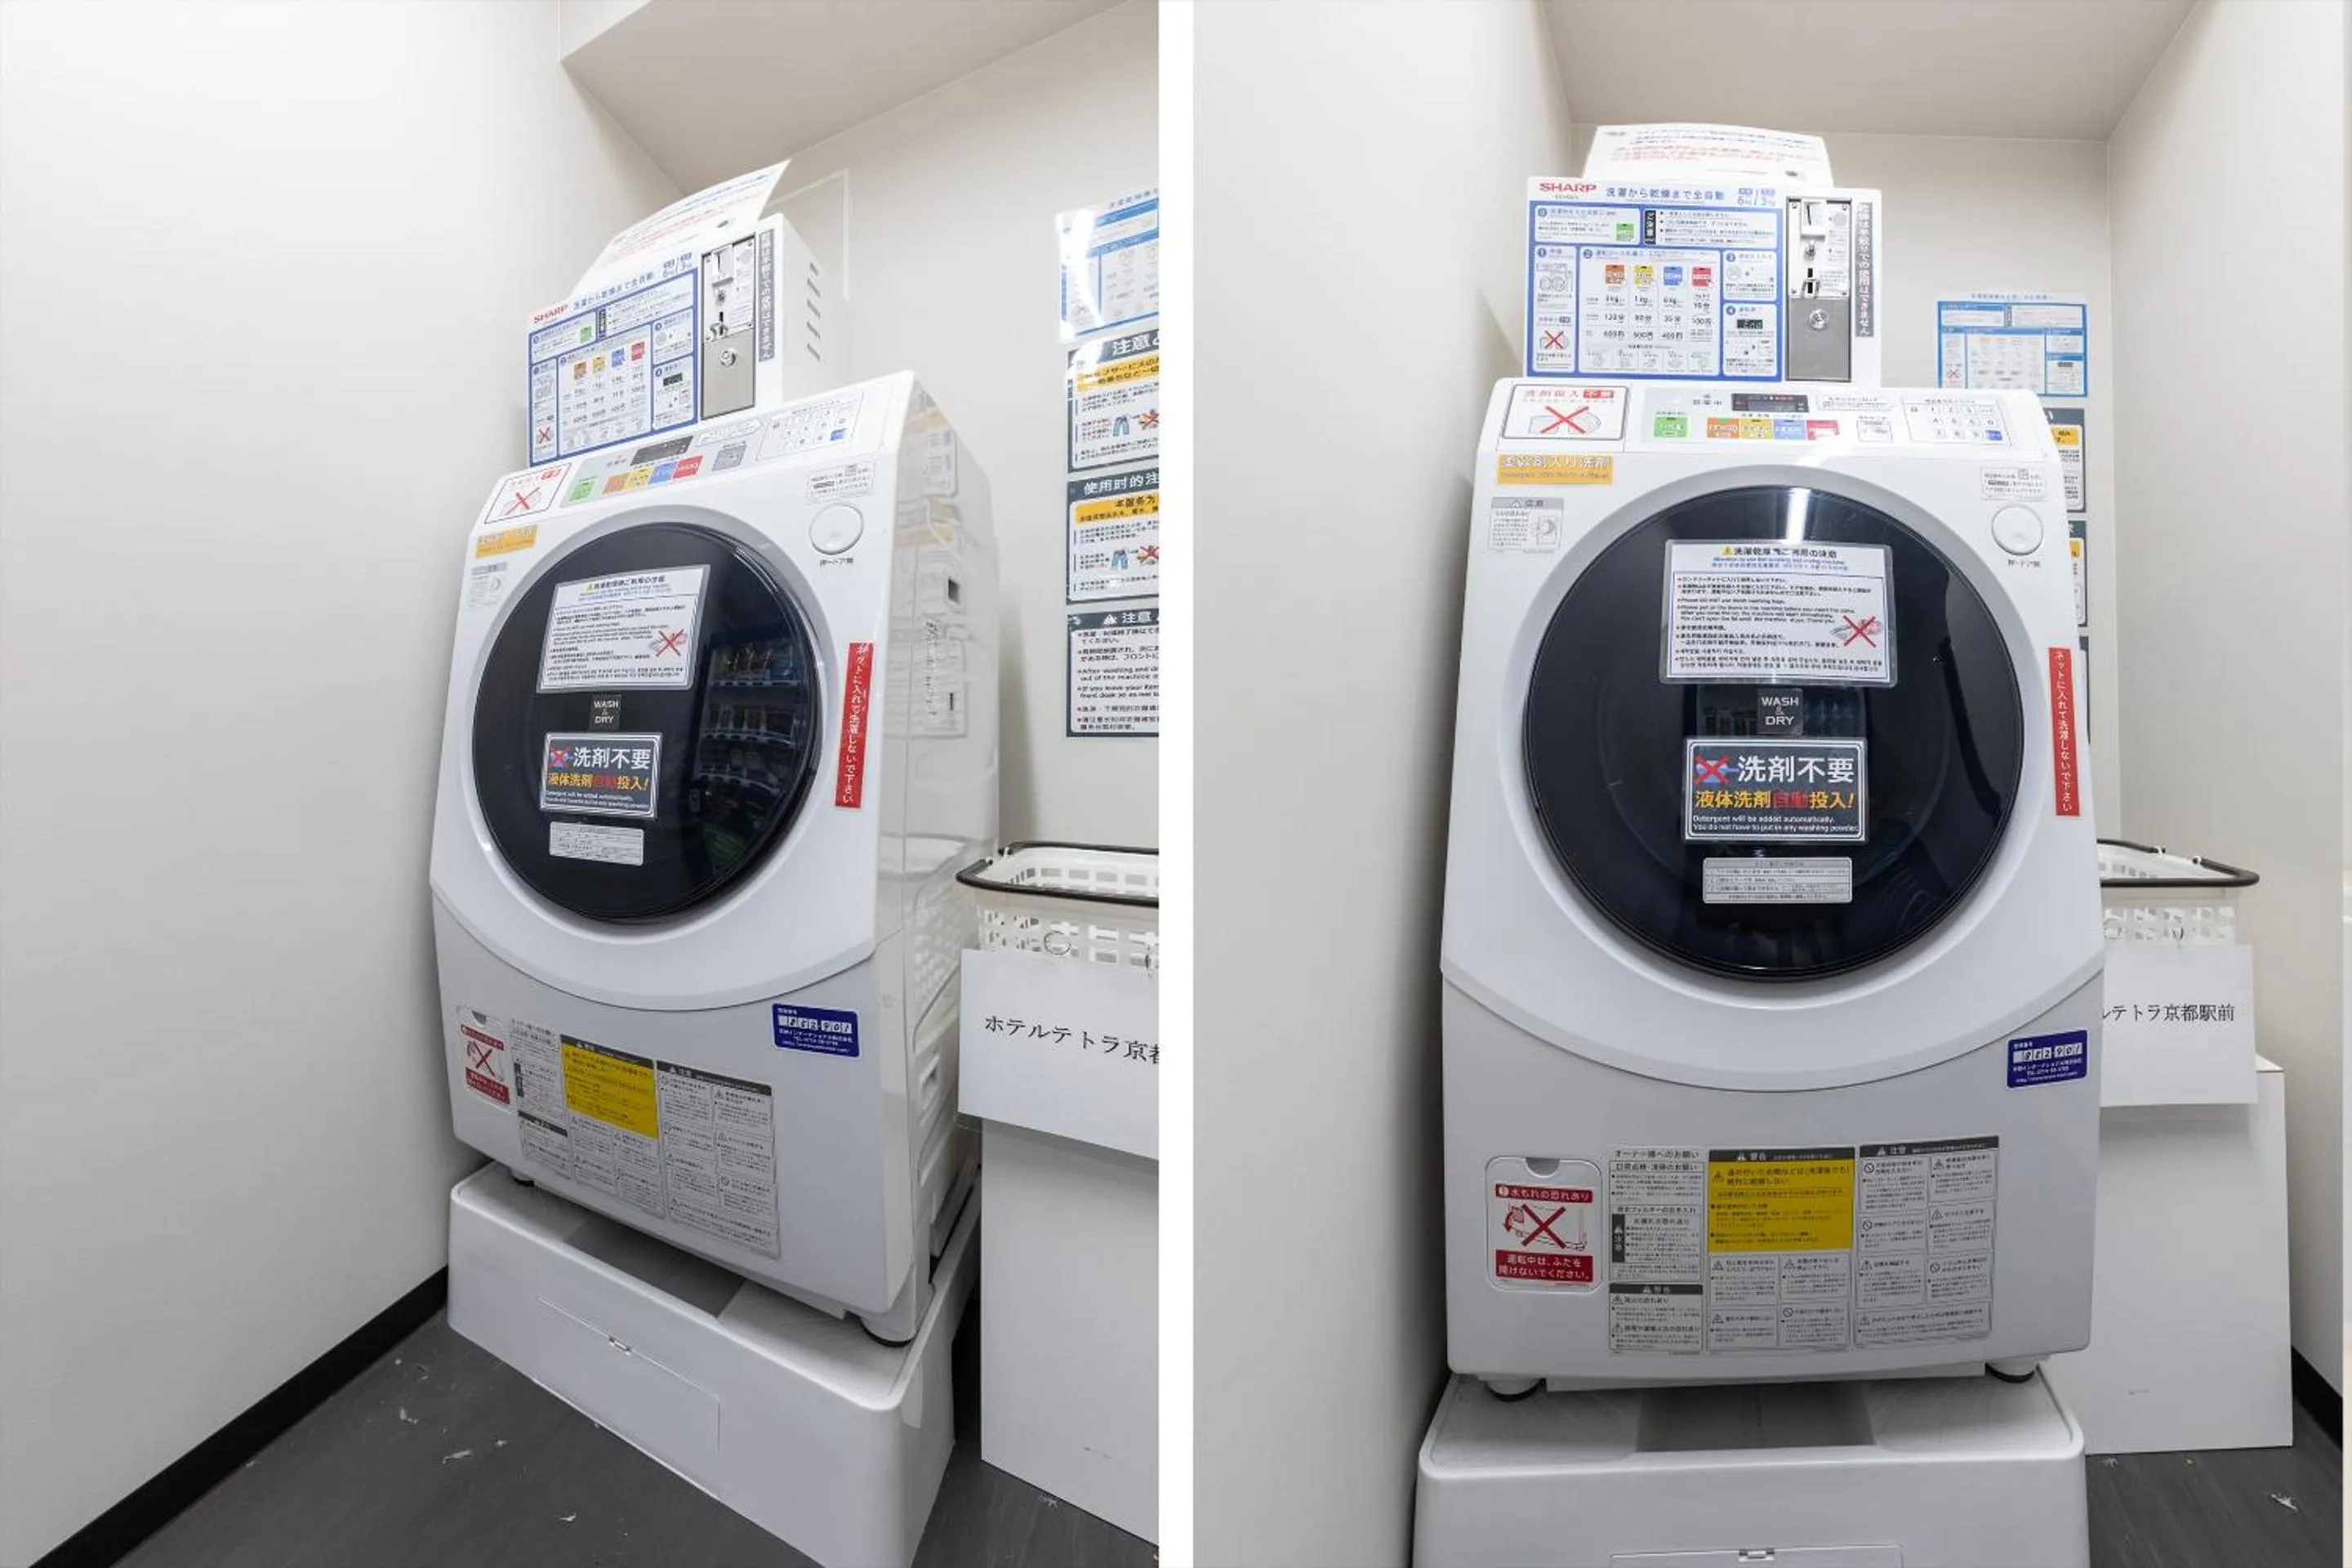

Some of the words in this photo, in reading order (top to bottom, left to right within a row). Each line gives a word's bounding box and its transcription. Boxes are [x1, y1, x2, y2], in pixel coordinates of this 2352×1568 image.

[1539, 183, 1597, 193] SHARP
[534, 304, 568, 323] SHARP
[594, 700, 619, 708] WASH
[1761, 697, 1799, 706] WASH
[595, 715, 614, 724] DRY
[1765, 715, 1794, 725] DRY
[572, 746, 652, 769] 洗剤不要
[1737, 755, 1855, 783] 洗剤不要
[1693, 815, 1731, 823] Detergent
[1798, 825, 1829, 833] washing
[1508, 1255, 1581, 1267] 運転中は、ふたを
[1498, 1266, 1590, 1280] 開けないでください。
